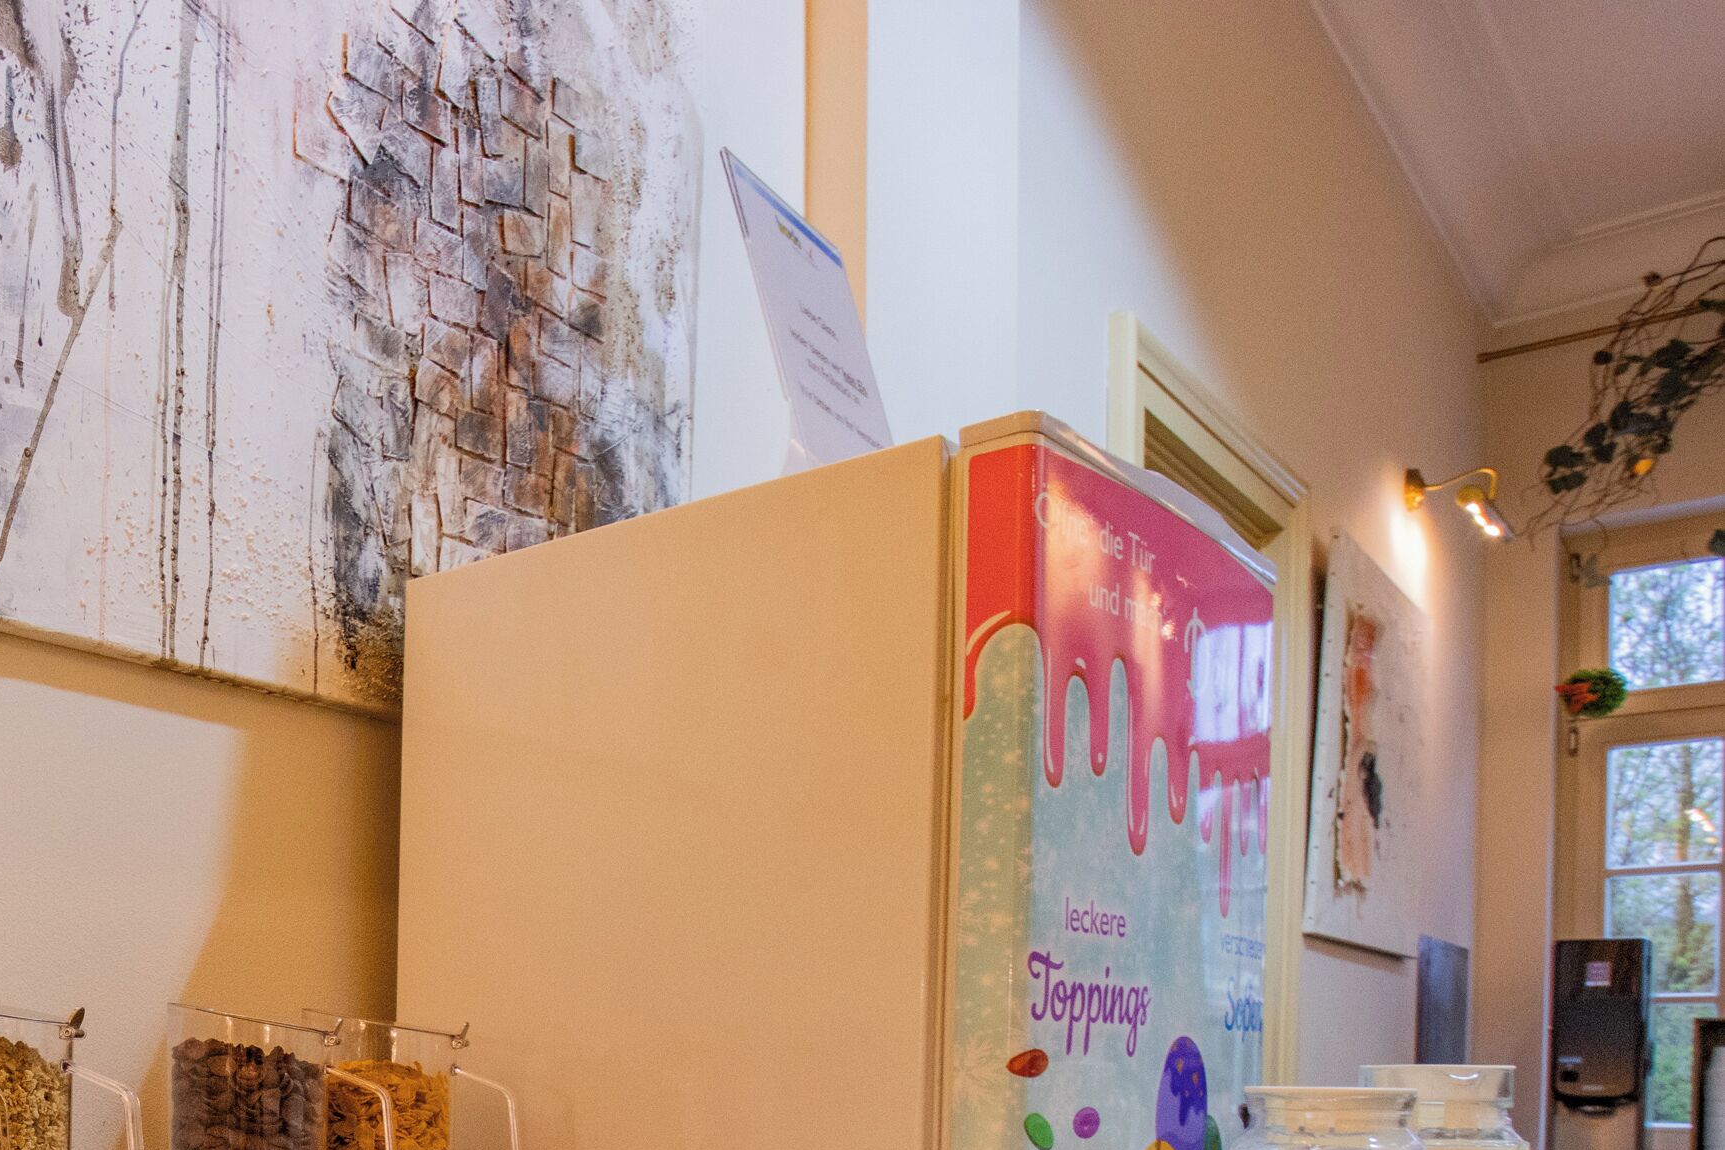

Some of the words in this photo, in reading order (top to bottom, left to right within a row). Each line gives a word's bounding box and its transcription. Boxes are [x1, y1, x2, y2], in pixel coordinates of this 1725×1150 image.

[1099, 521, 1124, 560] die
[1127, 530, 1156, 575] Tür
[1088, 583, 1121, 616] und
[1064, 896, 1126, 938] leckere
[1027, 950, 1151, 1058] Toppings
